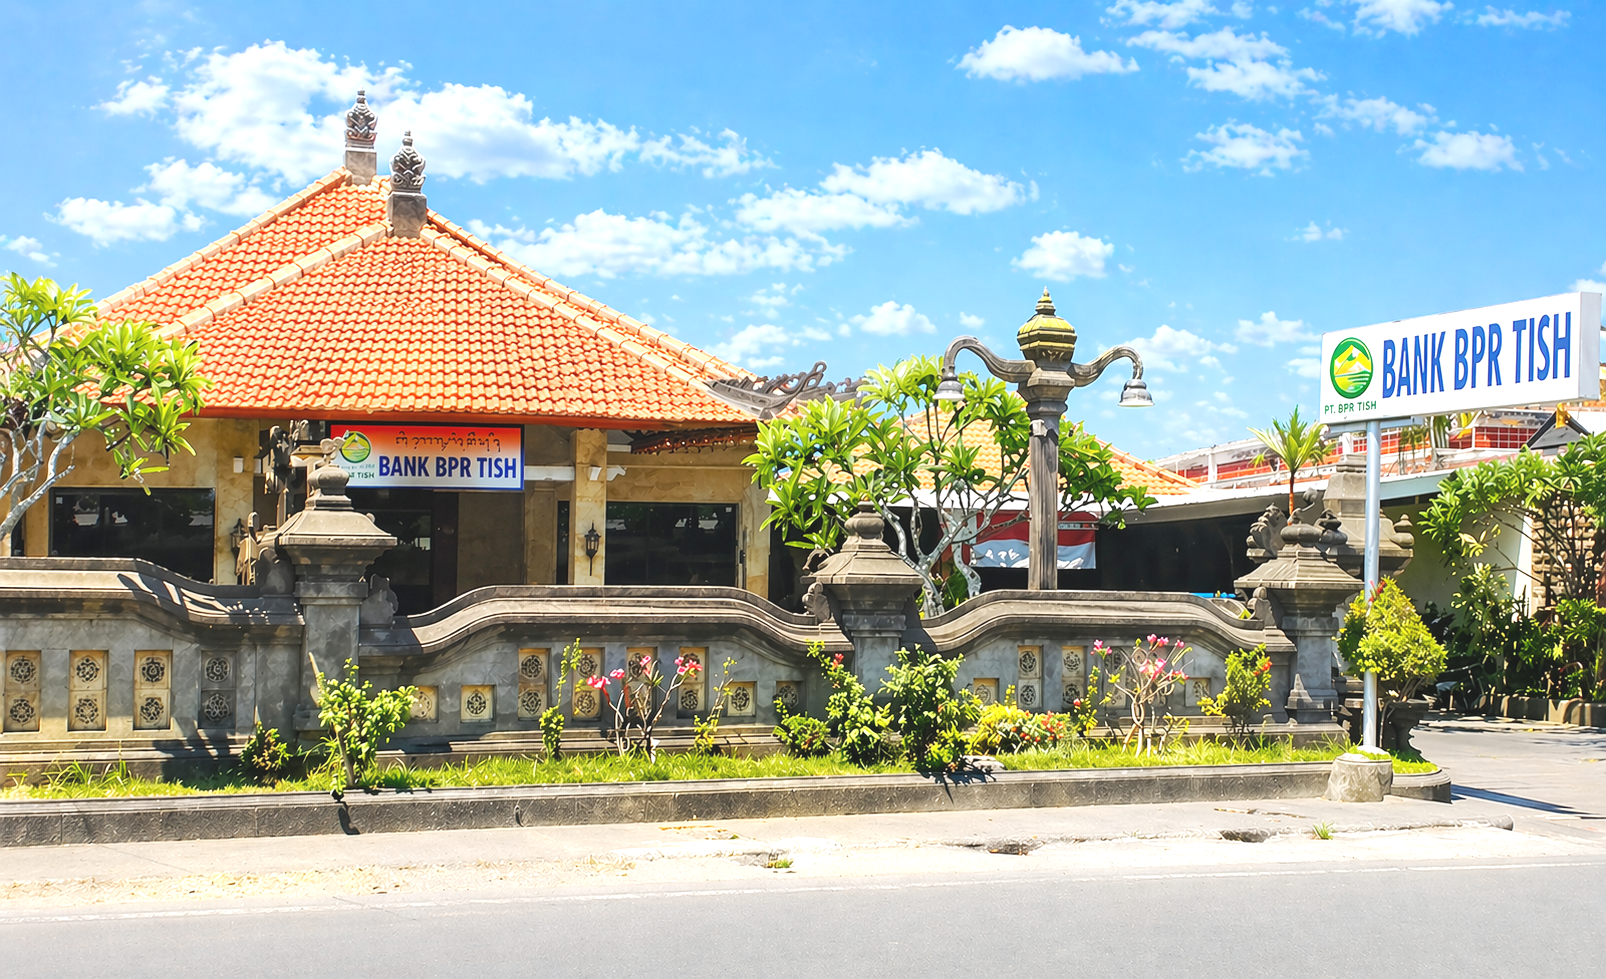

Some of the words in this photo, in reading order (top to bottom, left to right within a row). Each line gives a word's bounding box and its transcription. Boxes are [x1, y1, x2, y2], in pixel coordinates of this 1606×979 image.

[1382, 331, 1446, 399] BANK
[1454, 323, 1502, 390] BPR
[1512, 311, 1571, 384] TISH
[1324, 404, 1336, 414] PT.
[1338, 402, 1354, 413] BPR
[1357, 400, 1377, 411] TISH
[357, 471, 375, 479] TISH
[379, 455, 430, 477] BANK
[435, 456, 471, 478] BPR
[476, 457, 517, 479] TISH
